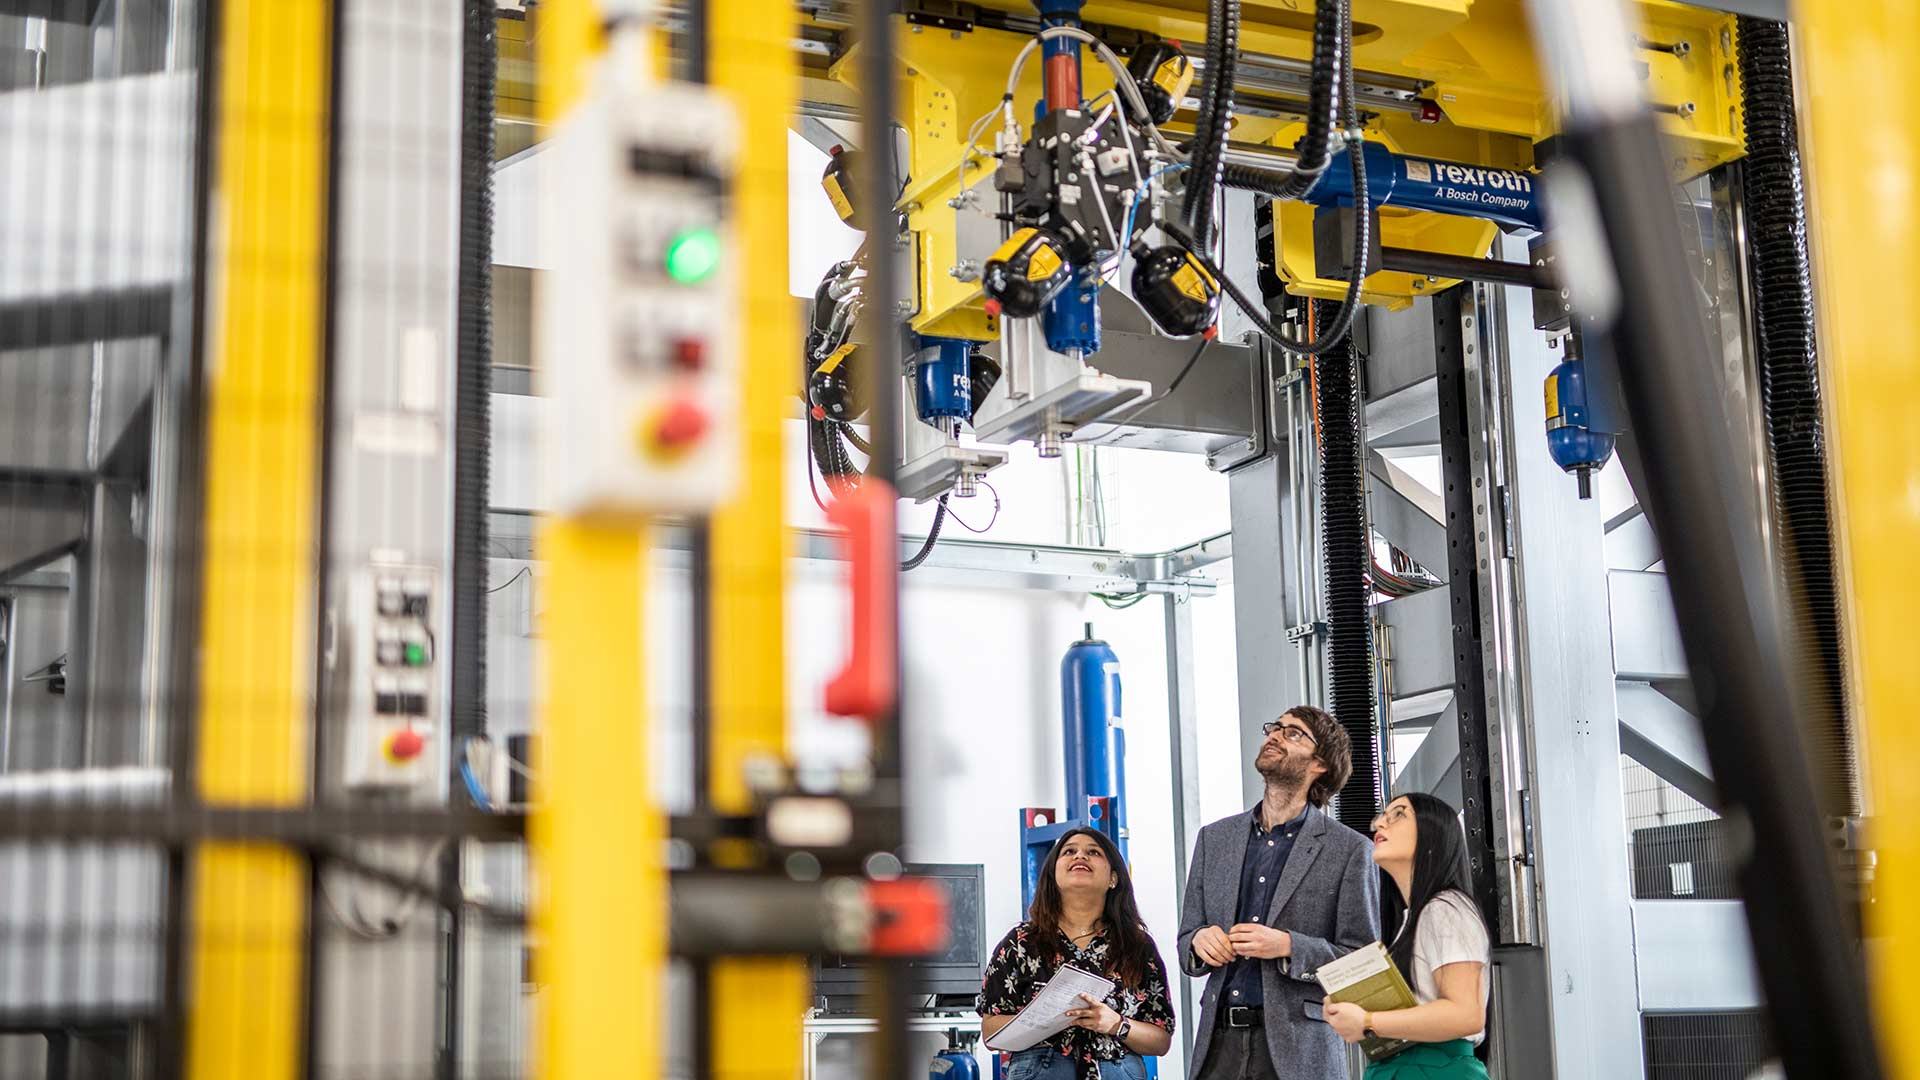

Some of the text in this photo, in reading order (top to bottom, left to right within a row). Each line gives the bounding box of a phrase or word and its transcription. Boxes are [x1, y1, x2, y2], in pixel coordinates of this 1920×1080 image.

[1435, 164, 1531, 192] rexroth
[1435, 187, 1530, 210] A Bosch Company
